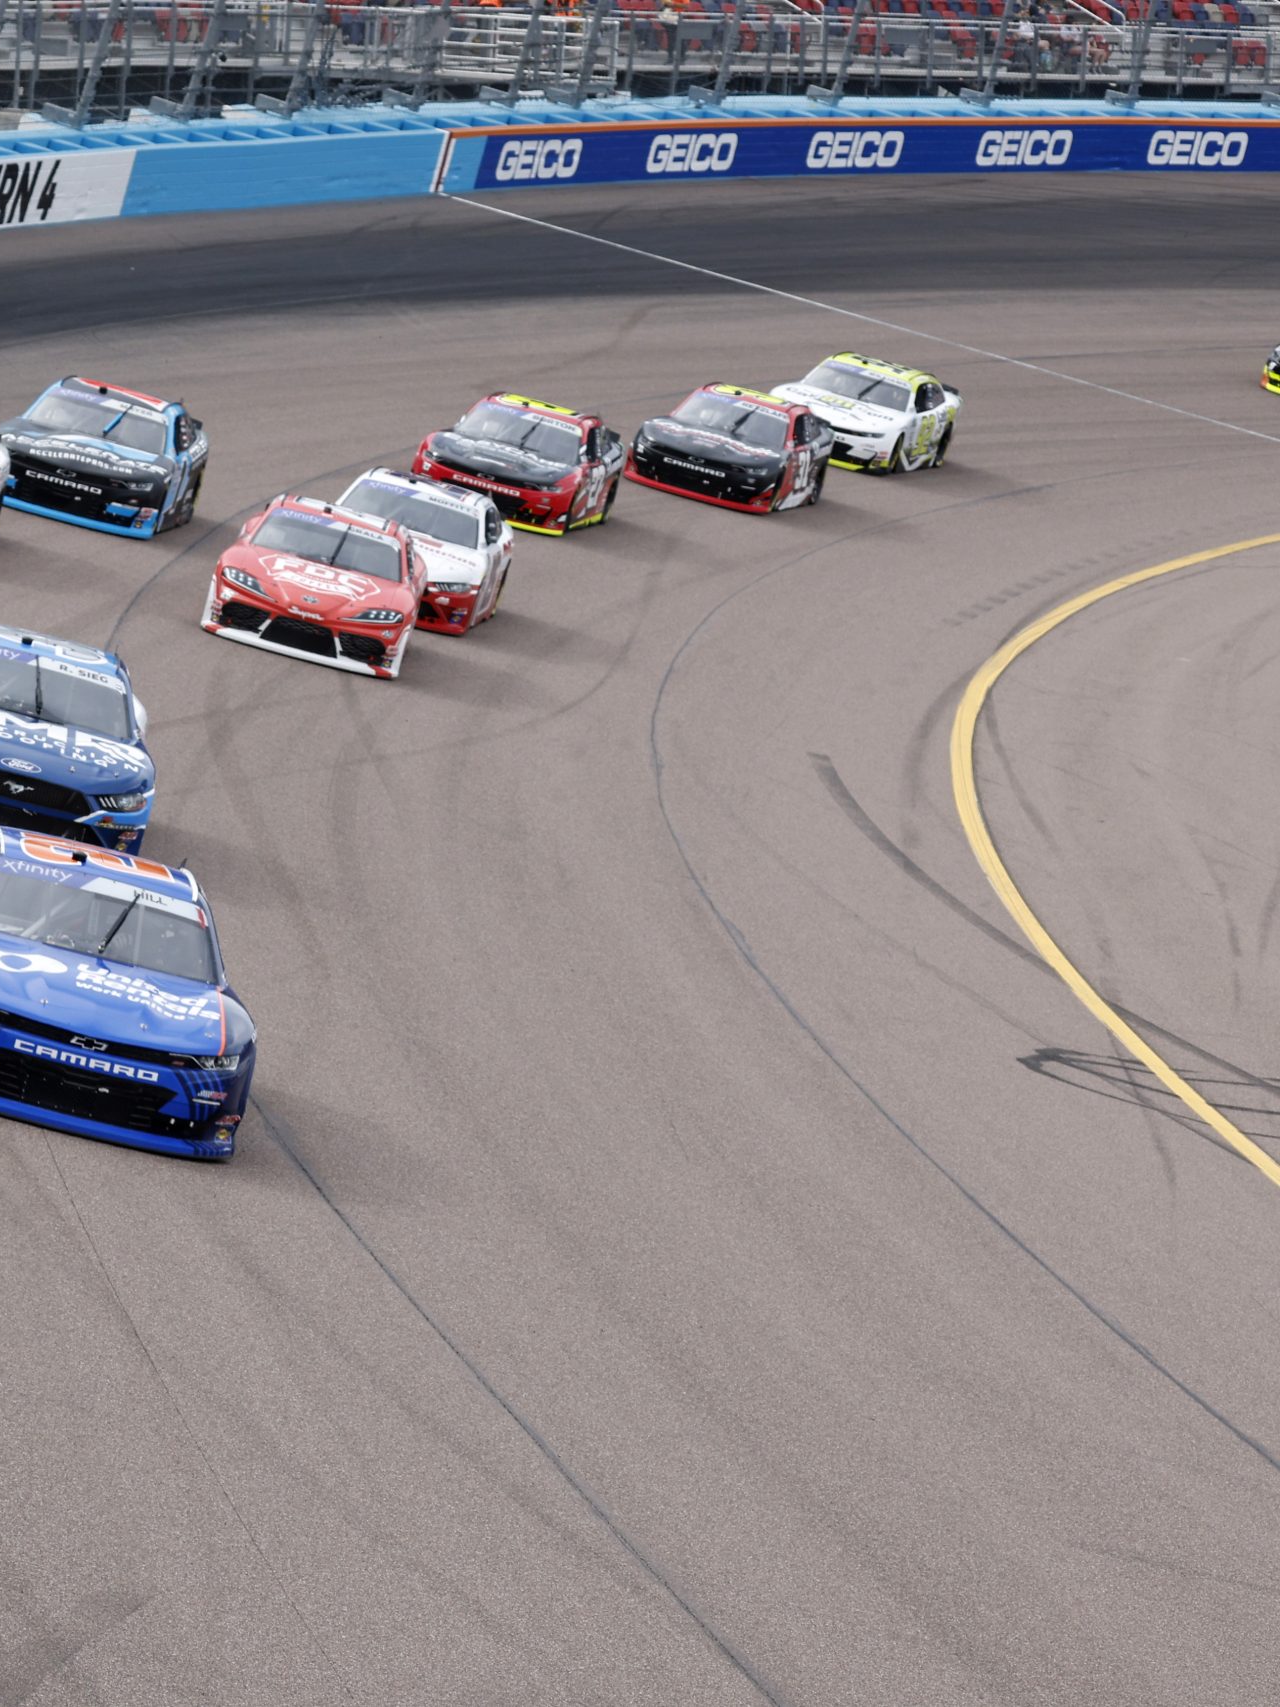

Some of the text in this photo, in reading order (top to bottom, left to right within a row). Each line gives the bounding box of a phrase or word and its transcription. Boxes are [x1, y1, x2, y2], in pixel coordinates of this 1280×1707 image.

[495, 138, 583, 181] GEICO
[646, 133, 739, 173] GEICO
[805, 131, 905, 168] GEICO
[976, 130, 1073, 166] GEICO
[1147, 130, 1249, 166] GEICO
[36, 159, 62, 221] 4
[25, 469, 103, 495] CAMARO
[663, 456, 726, 478] CAMARO
[452, 474, 520, 497] CAMARO
[282, 509, 322, 524] xfinity
[59, 664, 109, 684] R. SIEG
[6, 759, 35, 773] Ford
[3, 859, 73, 883] xfinity
[75, 981, 123, 998] Work
[75, 972, 221, 1021] Rentals
[76, 963, 209, 1008] United
[13, 1038, 160, 1083] CAMARO
